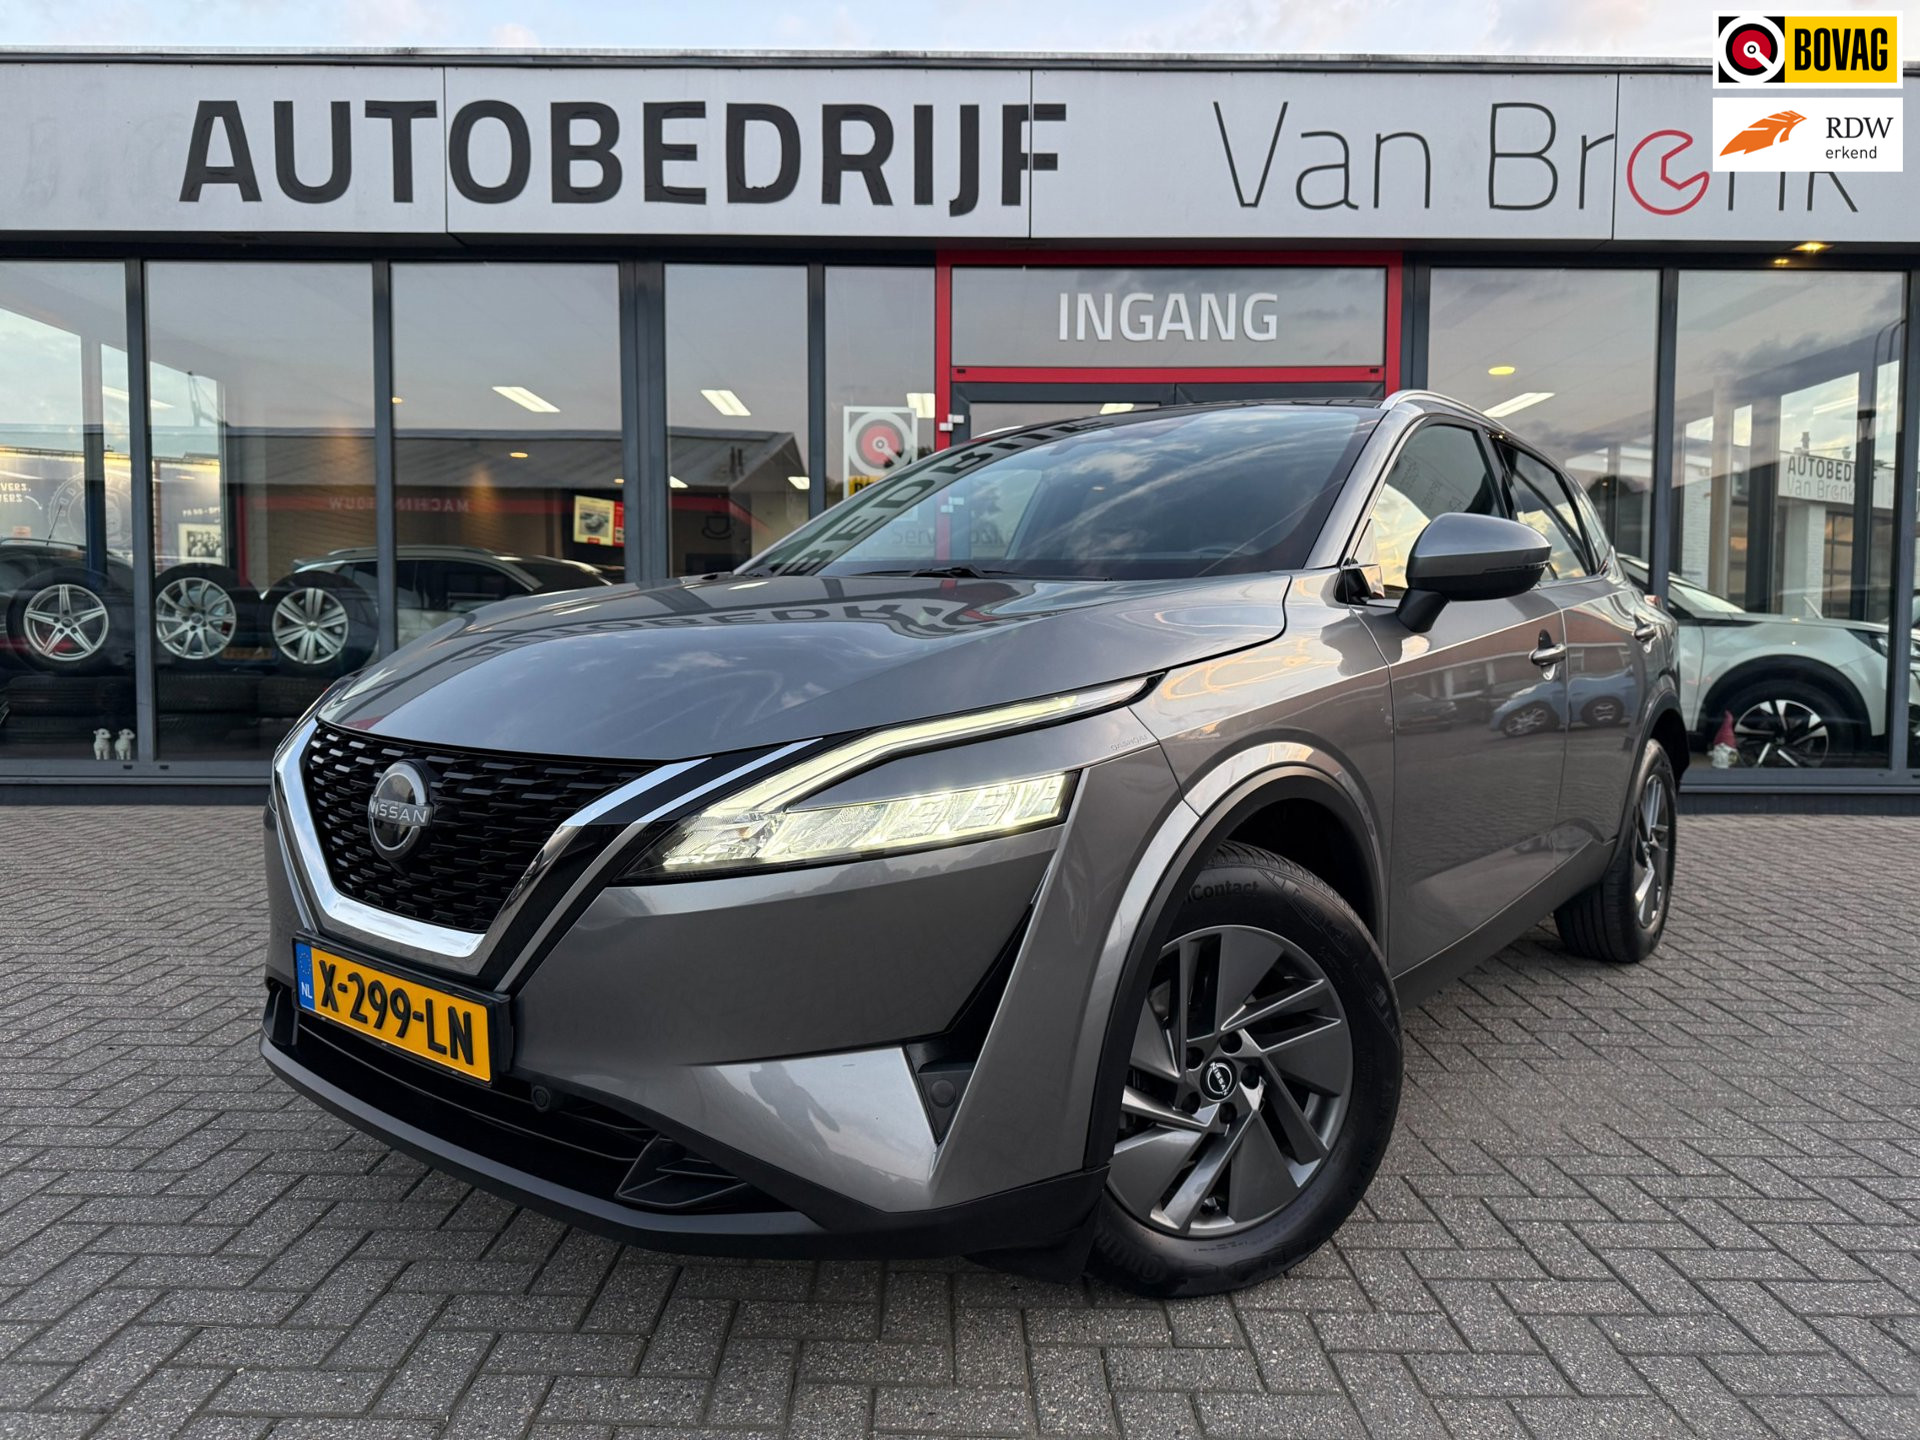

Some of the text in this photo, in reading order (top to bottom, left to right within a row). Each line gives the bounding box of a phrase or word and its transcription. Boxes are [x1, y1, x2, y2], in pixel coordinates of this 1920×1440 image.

[179, 99, 1067, 216] AUTOBEDRIJF
[1213, 101, 1432, 211] Van
[1058, 291, 1279, 343] INGANG
[369, 799, 427, 824] NISSAN
[1186, 881, 1260, 903] Contact
[301, 981, 313, 999] NL
[318, 959, 475, 1066] X-299-LN
